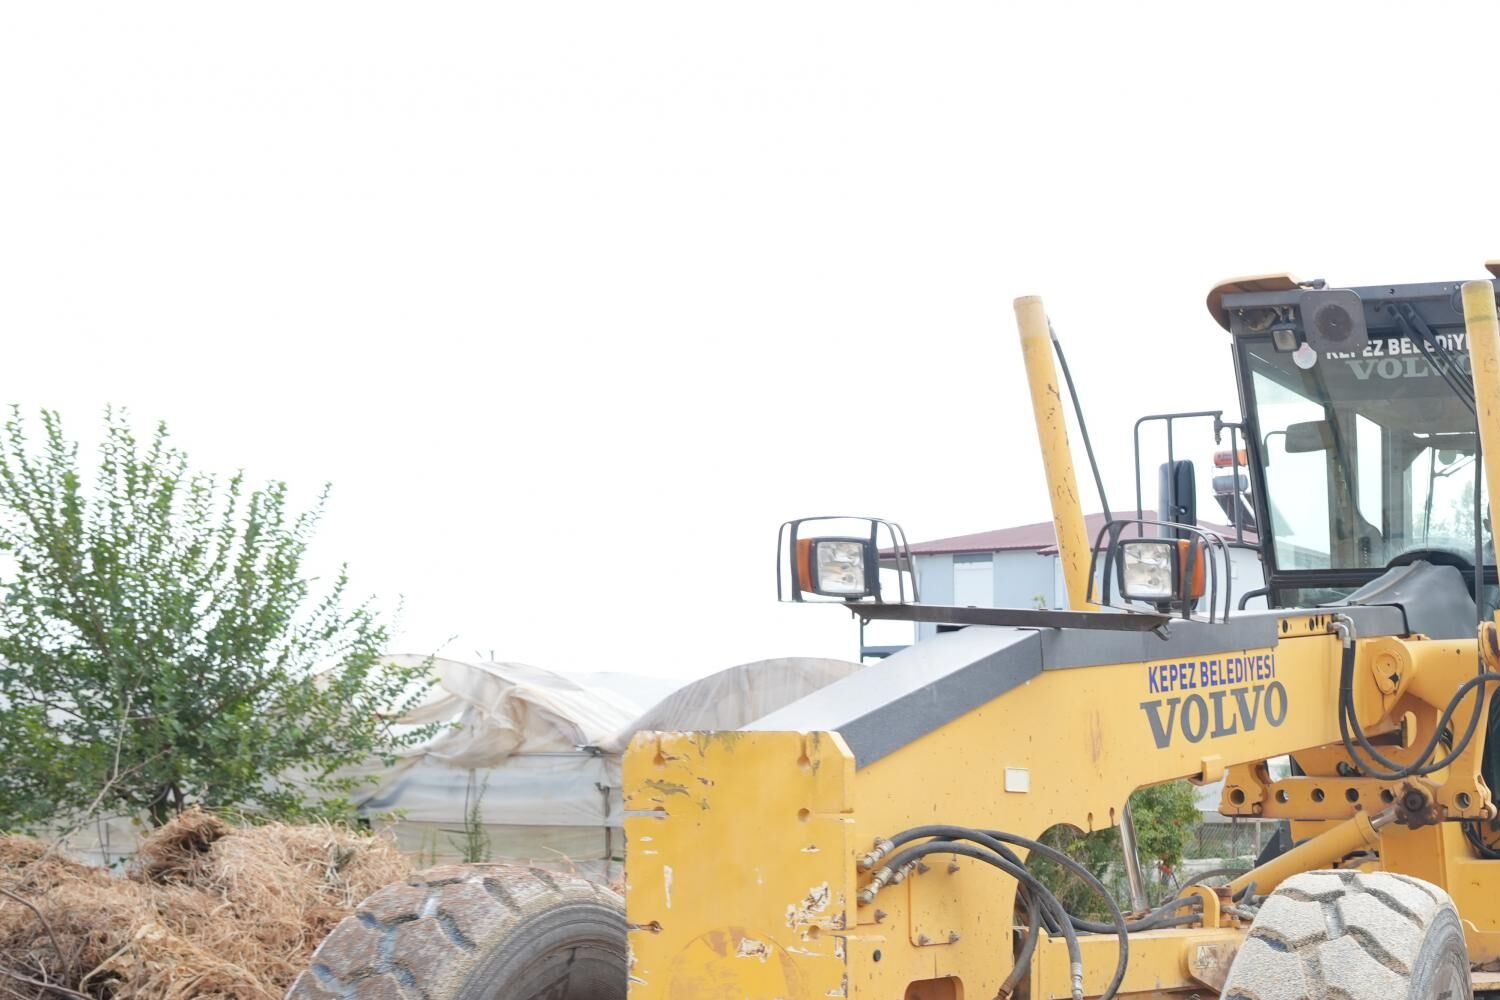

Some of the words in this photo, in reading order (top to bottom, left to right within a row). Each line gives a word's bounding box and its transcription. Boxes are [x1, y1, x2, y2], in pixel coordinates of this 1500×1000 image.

[1148, 662, 1197, 694] KEPEZ
[1200, 648, 1275, 687] BELEDİYESİ
[1140, 681, 1288, 749] VOLVO
